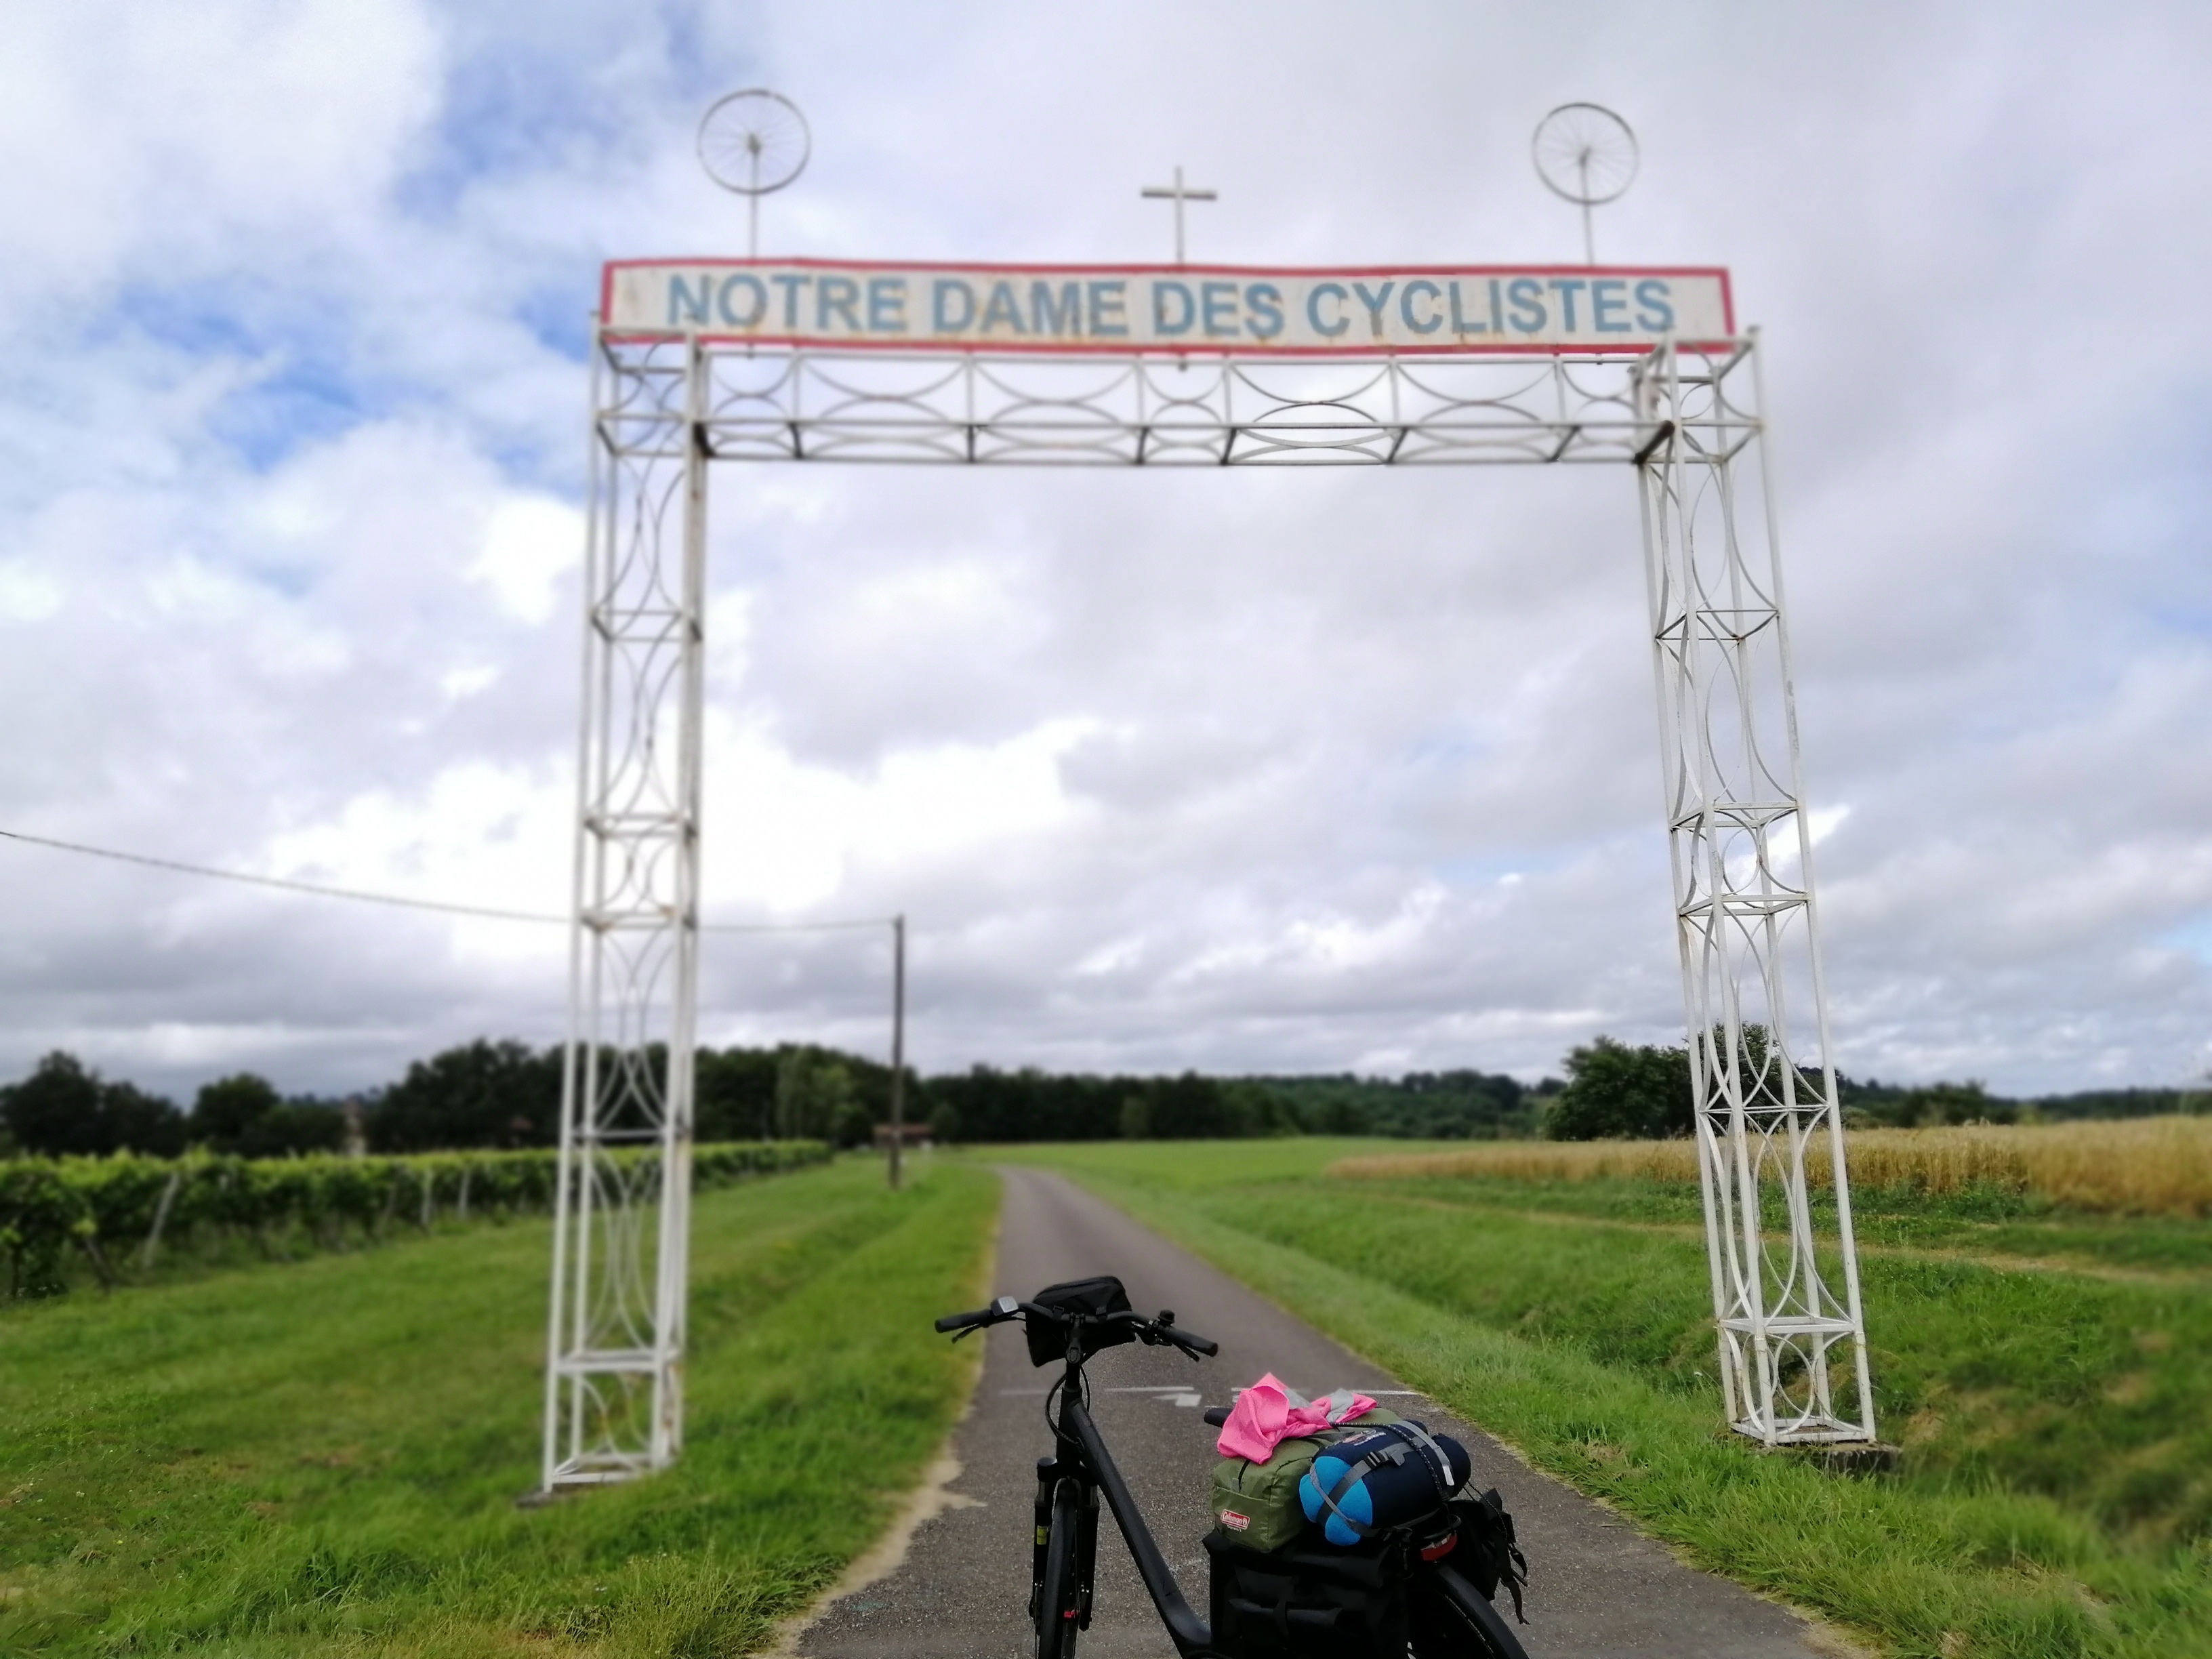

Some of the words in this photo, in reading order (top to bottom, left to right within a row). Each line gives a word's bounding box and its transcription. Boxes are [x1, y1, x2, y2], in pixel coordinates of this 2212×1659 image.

[668, 272, 907, 331] NOTRE
[933, 279, 1129, 335] DAME
[1153, 281, 1284, 337] DES
[1307, 279, 1675, 337] CYCLISTES
